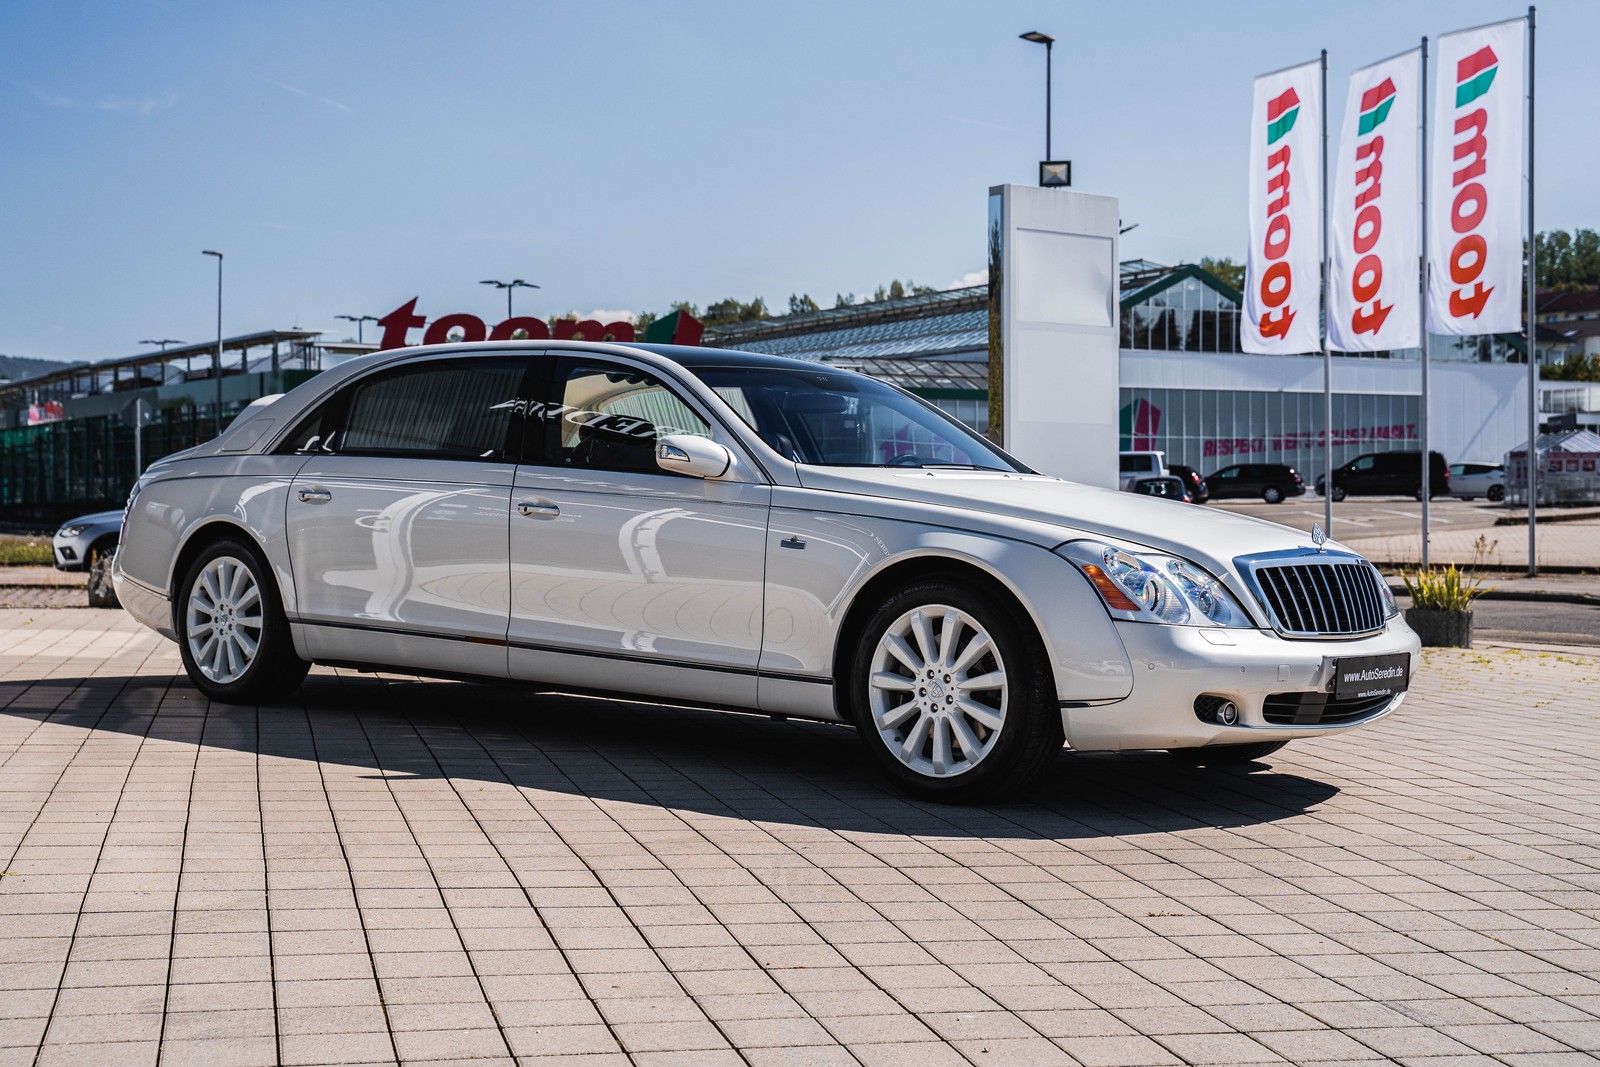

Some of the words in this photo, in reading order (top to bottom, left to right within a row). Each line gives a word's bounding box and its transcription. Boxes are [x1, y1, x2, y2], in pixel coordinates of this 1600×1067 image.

[1259, 145, 1297, 340] toom
[1351, 135, 1394, 336] toom
[1449, 107, 1495, 320] toom
[377, 296, 635, 350] toom
[1344, 665, 1403, 682] www.AutoSeredin.de
